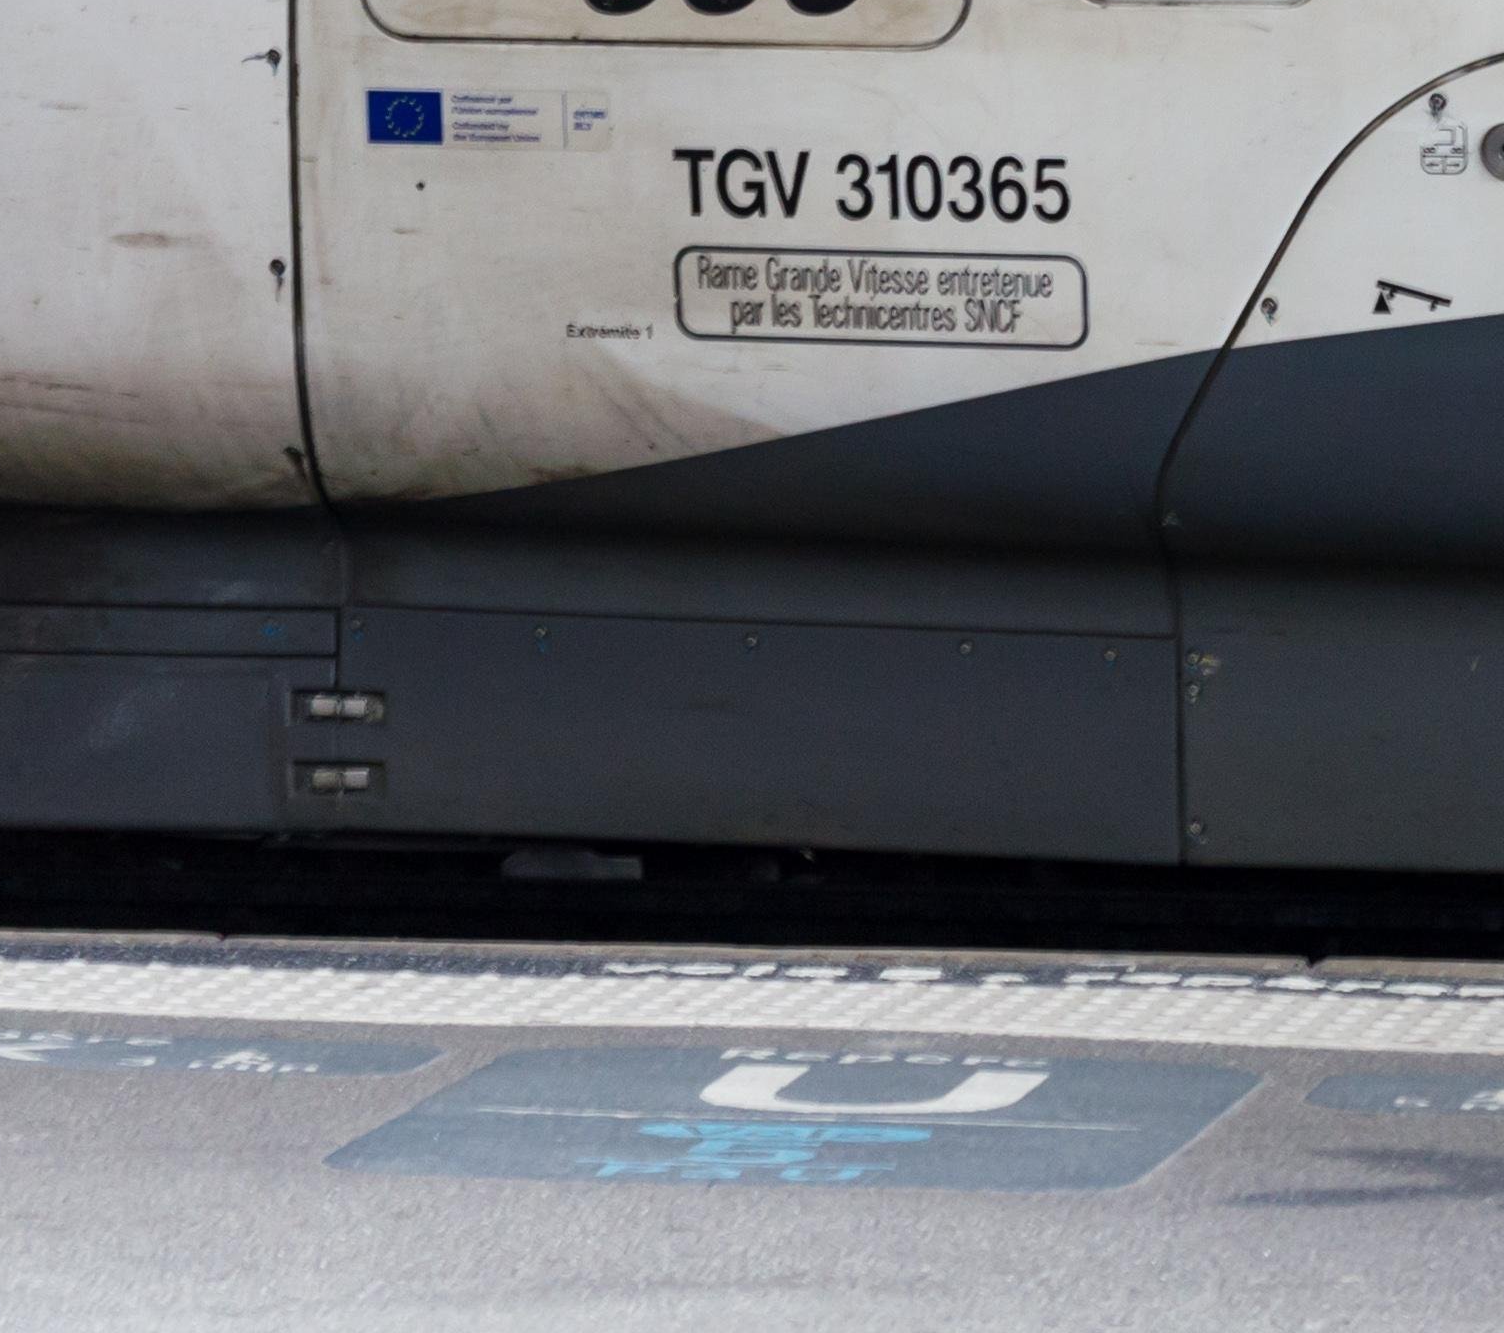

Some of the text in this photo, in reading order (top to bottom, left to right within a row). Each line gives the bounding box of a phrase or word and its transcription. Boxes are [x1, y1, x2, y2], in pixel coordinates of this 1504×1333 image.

[673, 148, 1071, 224] TGV 310365
[698, 255, 1054, 299] Rame Grande Vitesse entretenue
[729, 295, 1024, 334] par les Technicentres SNCF
[700, 1063, 1051, 1115] U
